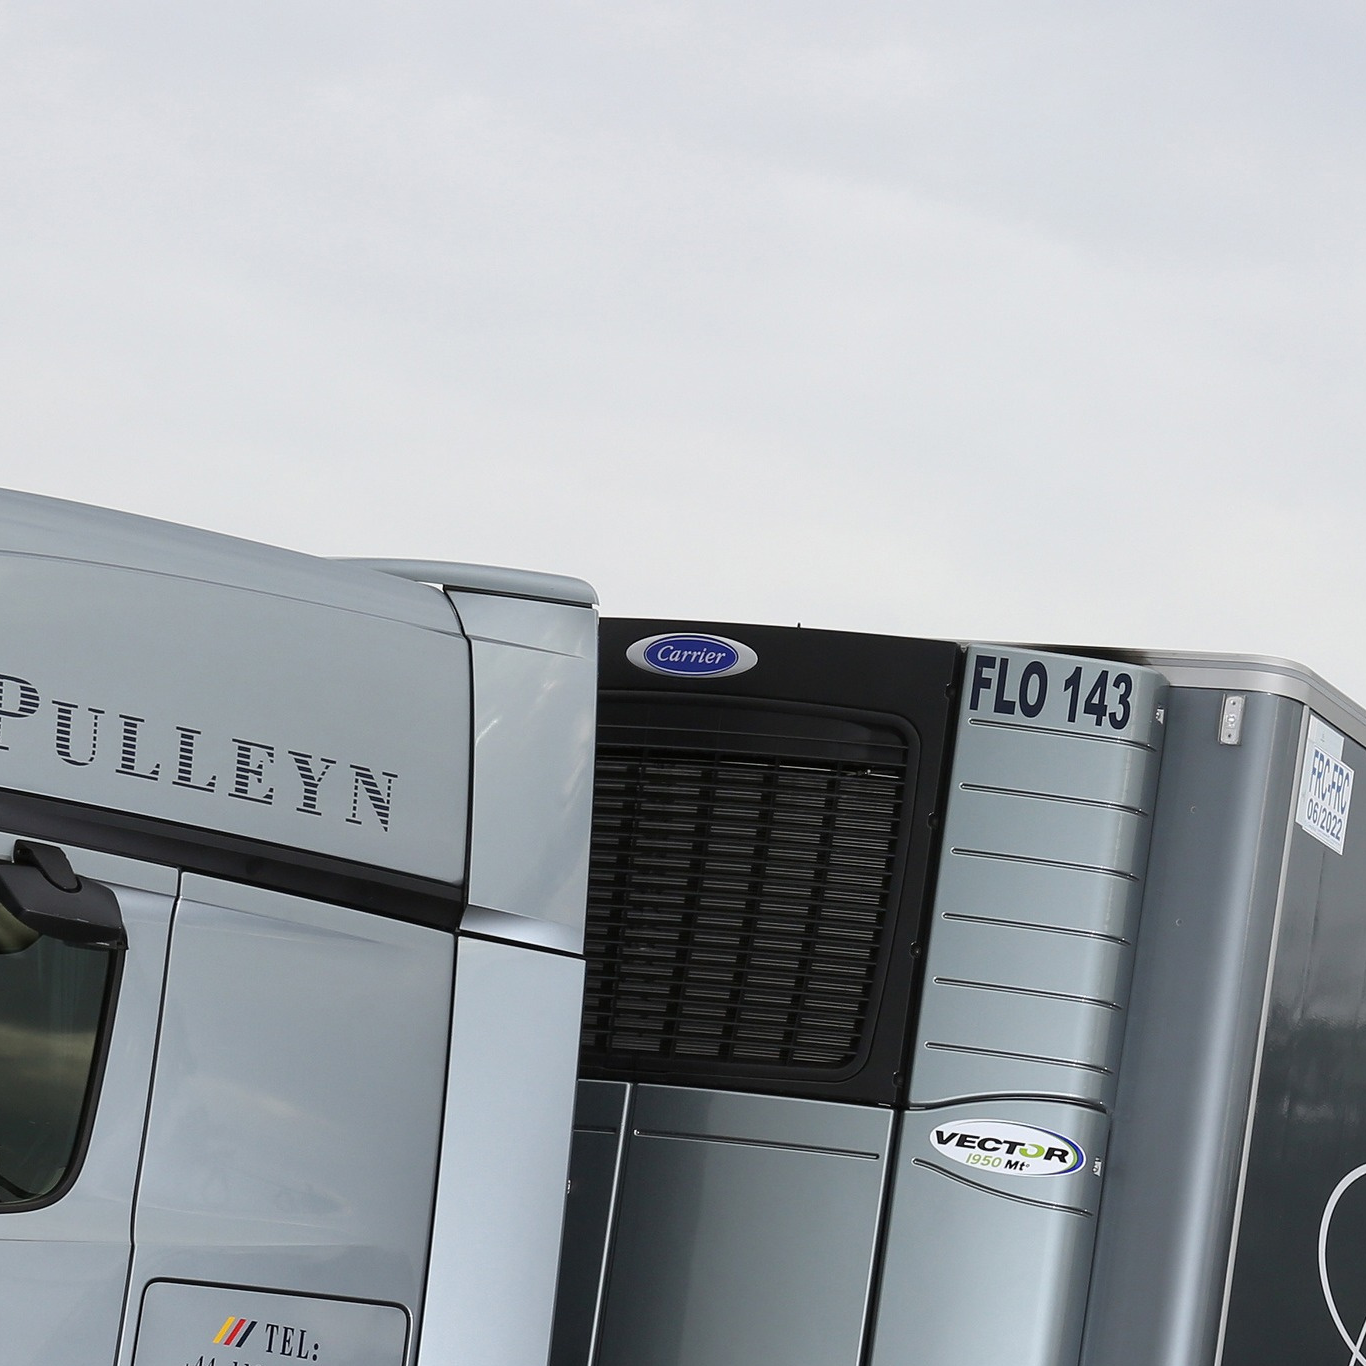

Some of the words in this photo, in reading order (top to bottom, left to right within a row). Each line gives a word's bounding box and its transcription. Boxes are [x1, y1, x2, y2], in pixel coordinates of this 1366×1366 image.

[657, 645, 726, 664] Carrier
[969, 654, 1048, 718] FLO
[1063, 666, 1133, 730] 143
[1309, 748, 1350, 815] FRC-FRC
[1307, 797, 1343, 841] 06/2022
[935, 1130, 1070, 1164] VECTOR
[965, 1153, 1002, 1168] 1950
[265, 1323, 320, 1361] TEL:
